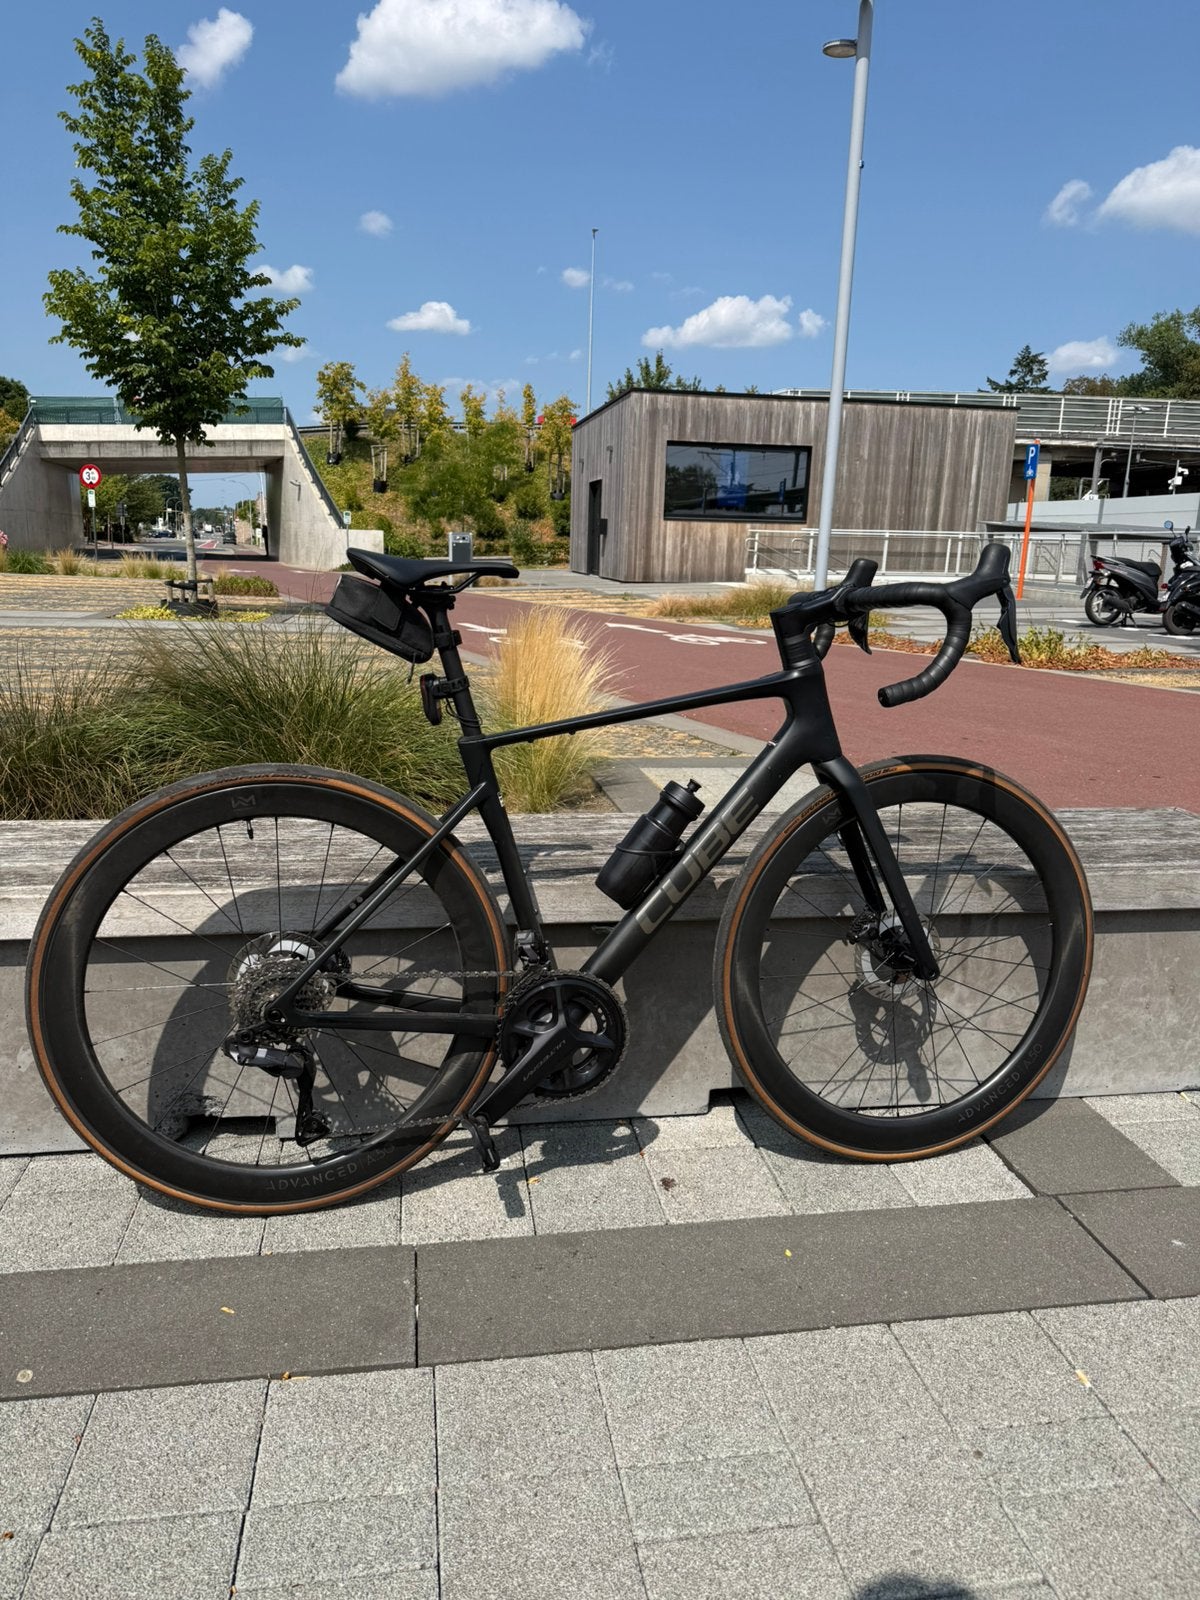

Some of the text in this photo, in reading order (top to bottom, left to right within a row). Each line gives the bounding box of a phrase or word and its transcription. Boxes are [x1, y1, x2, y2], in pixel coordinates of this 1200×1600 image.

[1028, 446, 1036, 465] P
[636, 787, 759, 934] CUBE
[958, 1071, 1020, 1123] ADVANCED
[265, 1162, 359, 1191] ADVANCED
